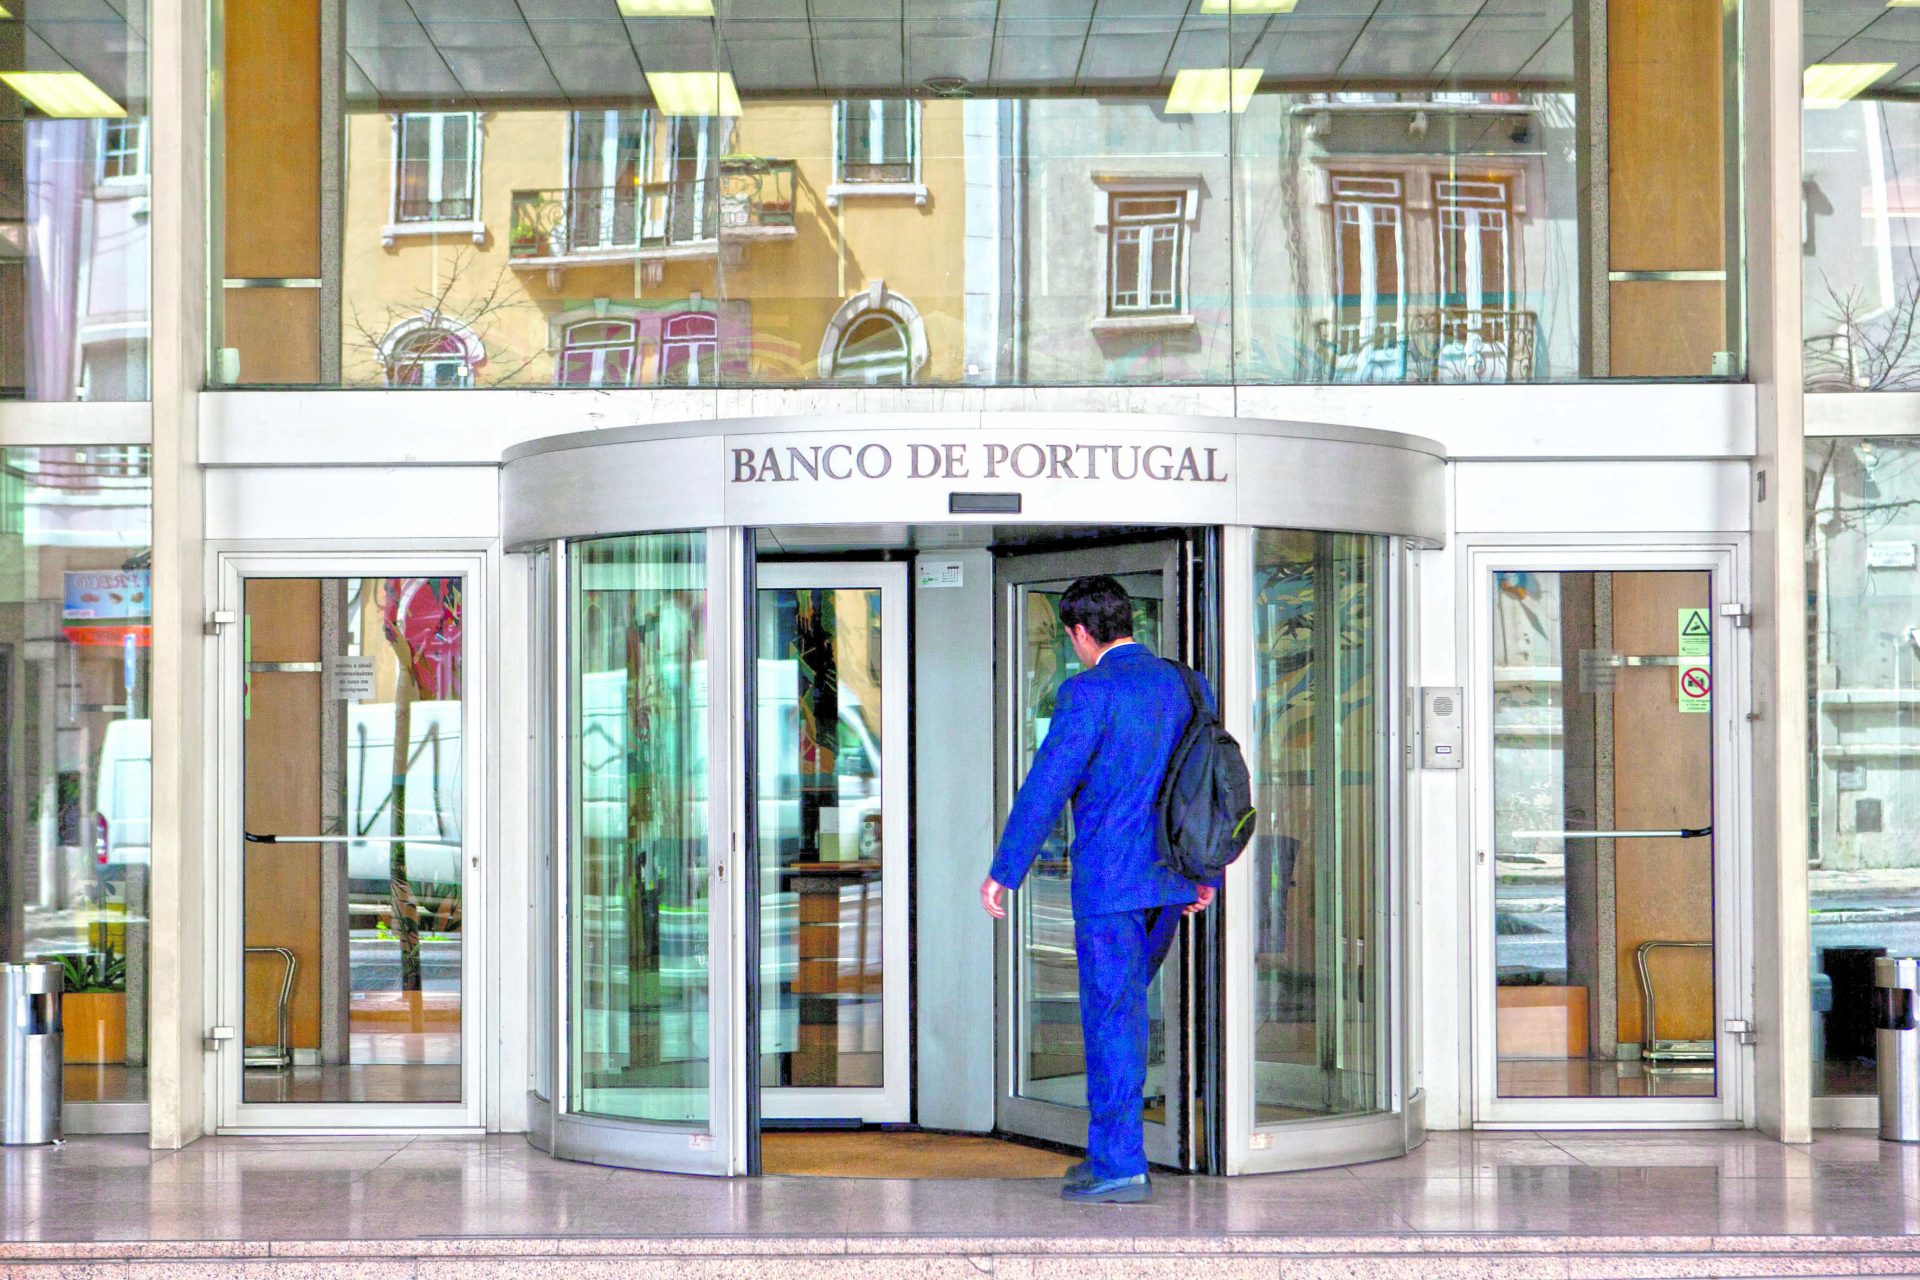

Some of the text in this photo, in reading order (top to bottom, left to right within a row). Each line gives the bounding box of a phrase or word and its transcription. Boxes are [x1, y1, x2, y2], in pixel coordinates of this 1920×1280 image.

[731, 442, 1229, 483] BANCO DE PORTUGAL
